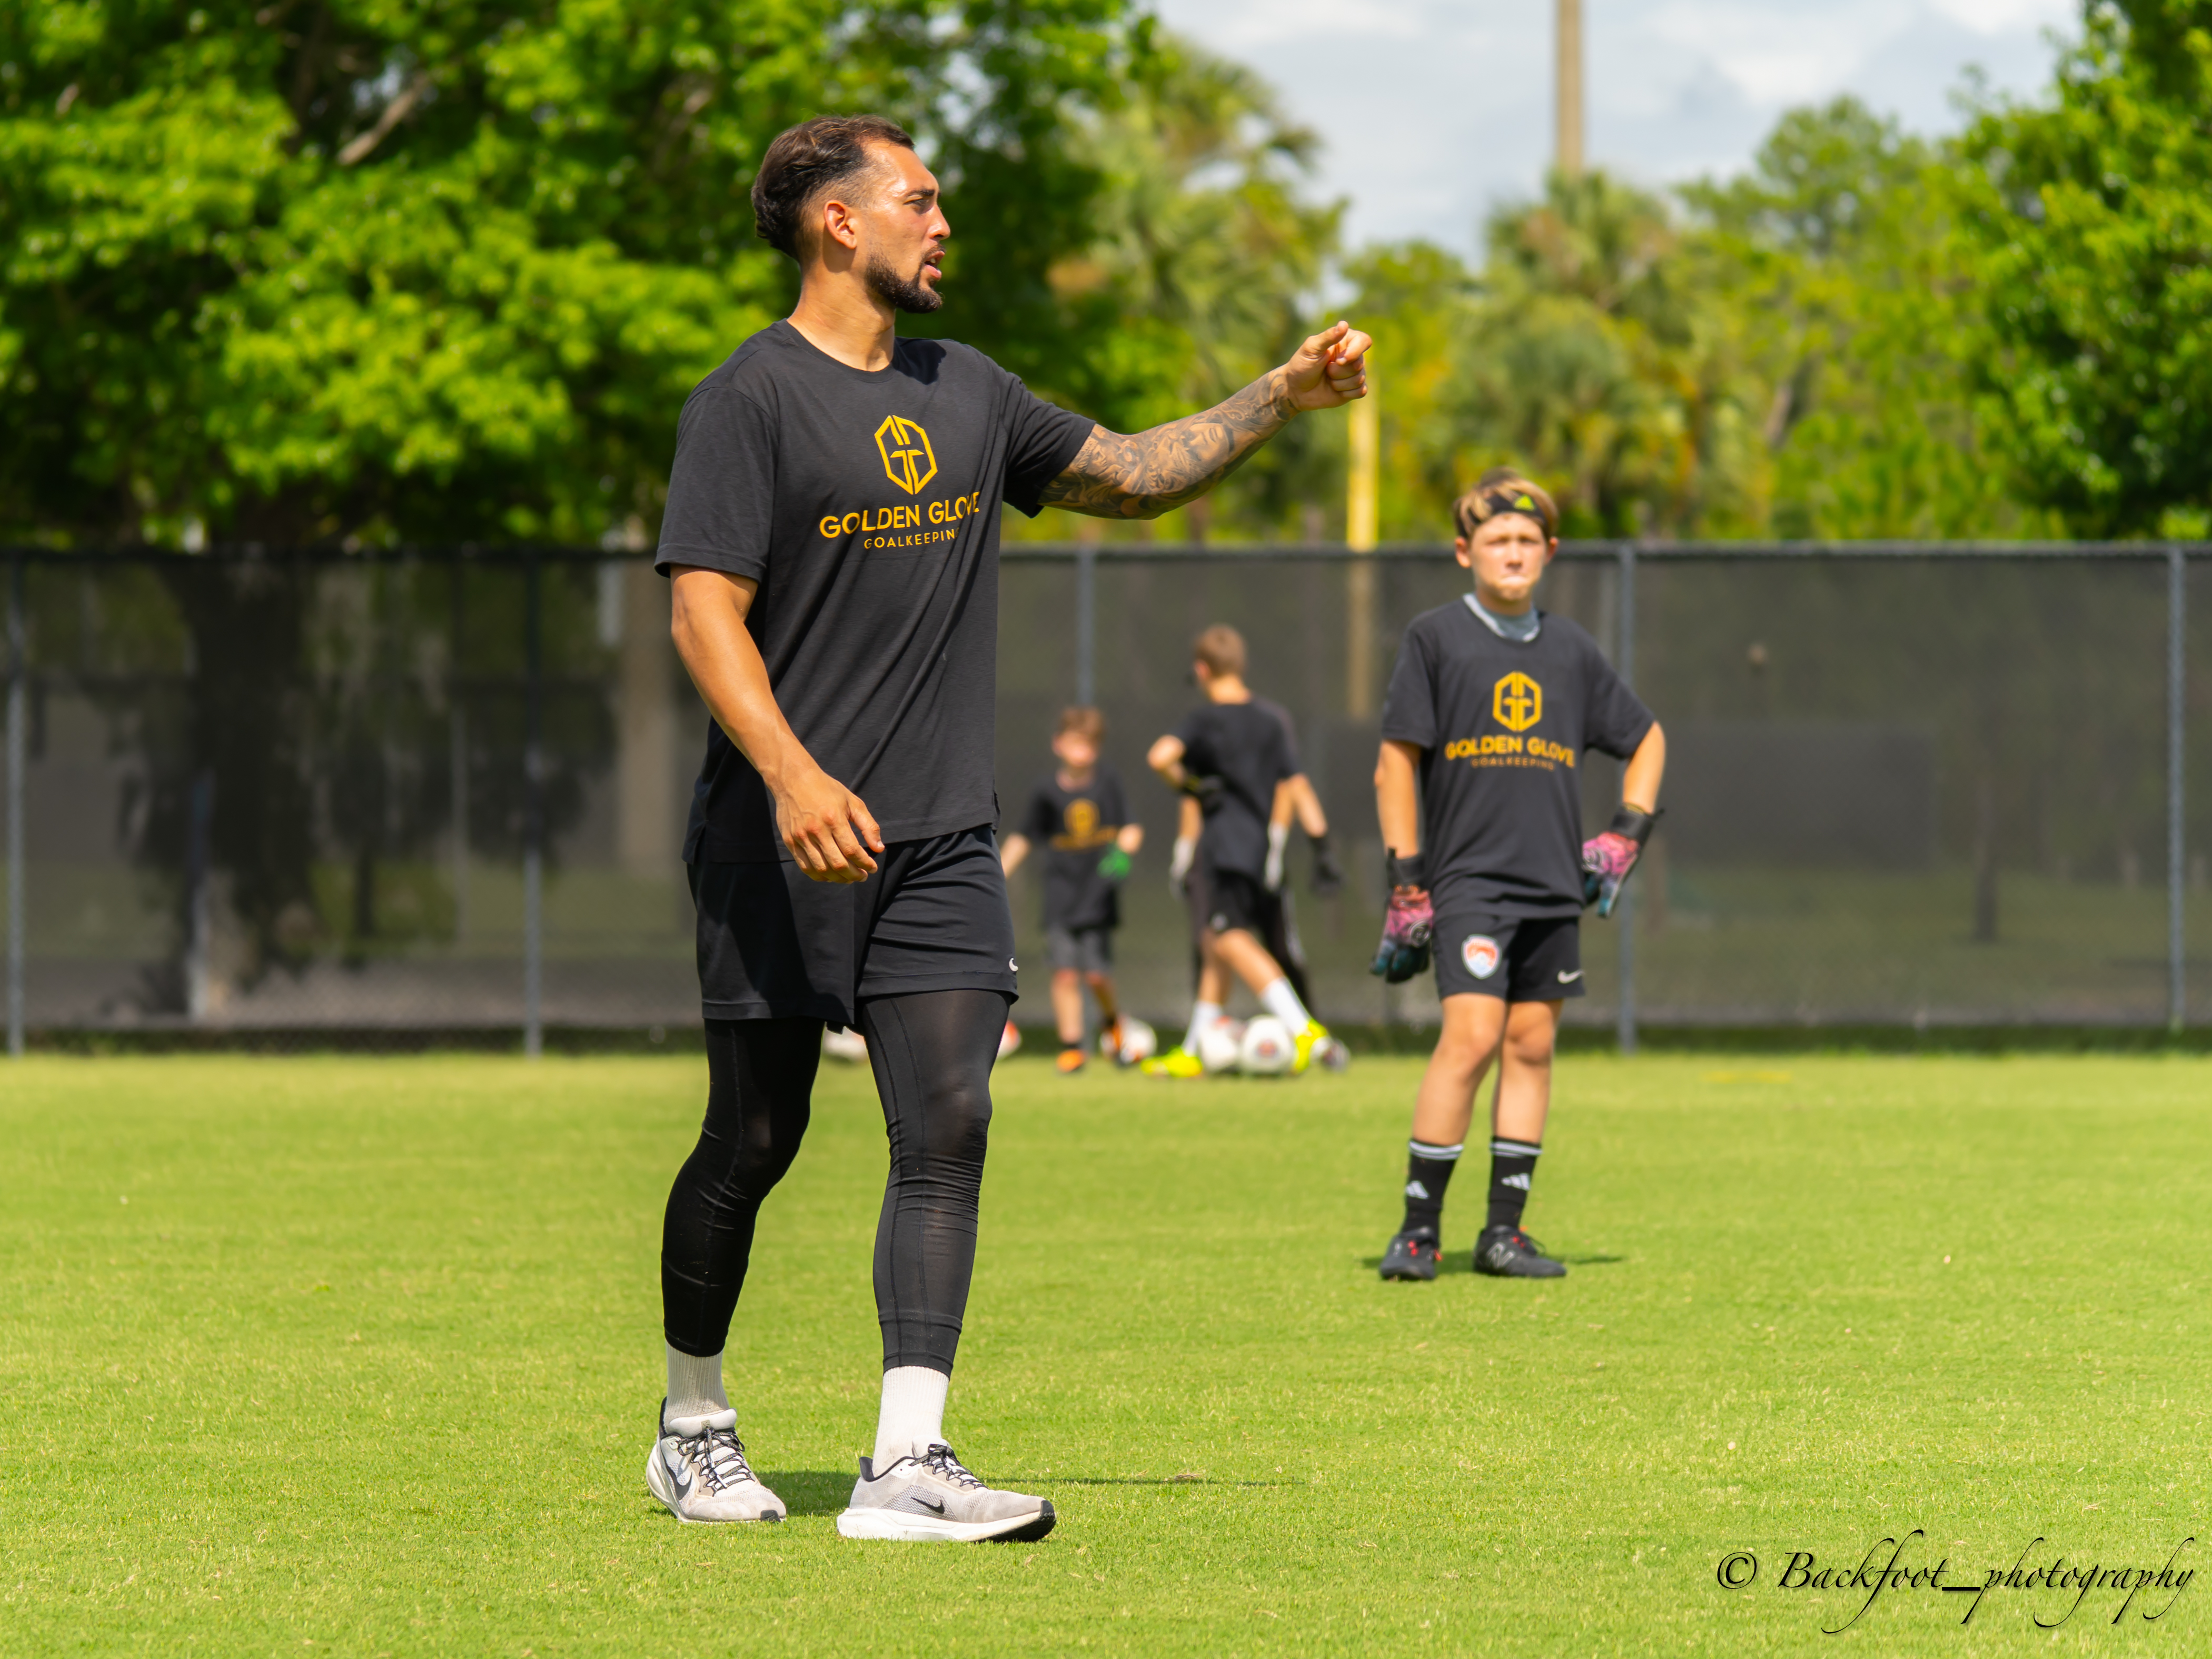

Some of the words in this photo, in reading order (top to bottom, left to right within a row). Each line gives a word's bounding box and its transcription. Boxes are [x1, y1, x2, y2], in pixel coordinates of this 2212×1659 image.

[819, 504, 921, 539] GOLDEN
[928, 491, 980, 524] GLOVE
[1444, 735, 1523, 761] GOLDEN
[1527, 737, 1575, 769] GLOVE
[1471, 756, 1554, 772] GOALKEEPING
